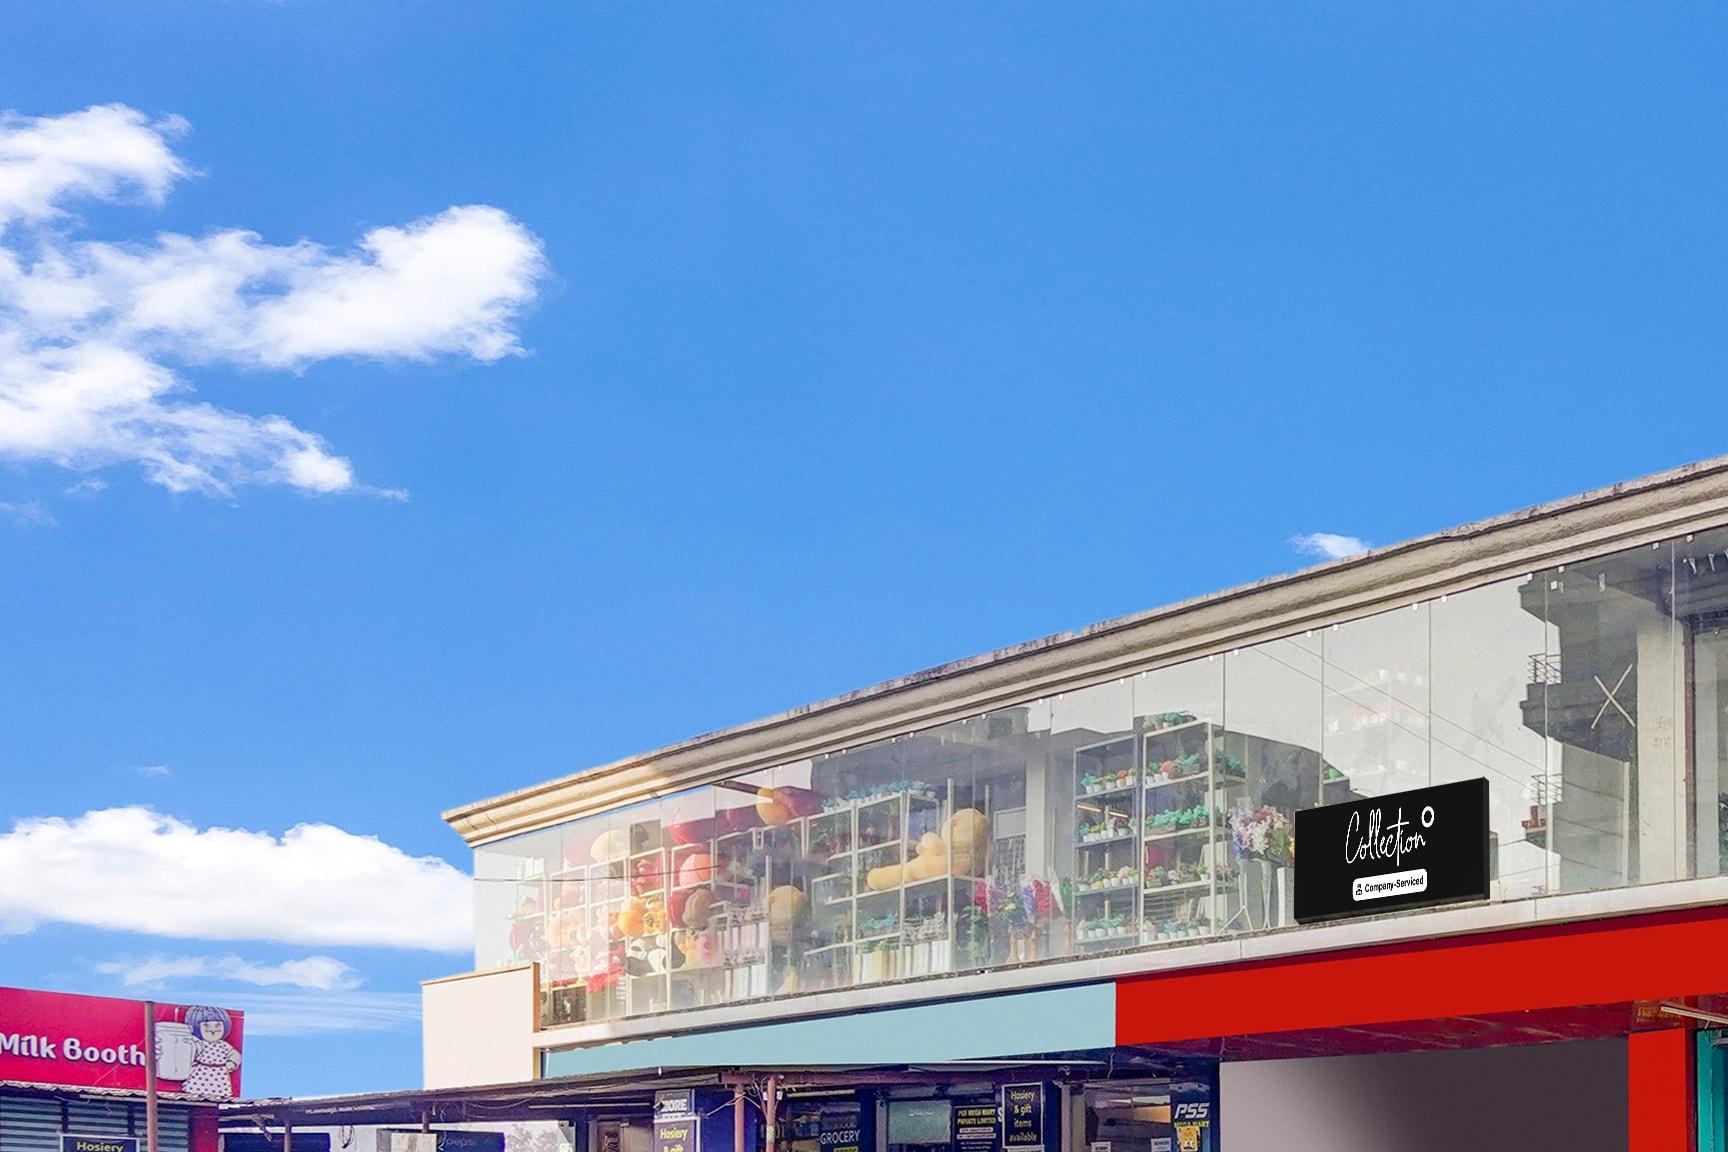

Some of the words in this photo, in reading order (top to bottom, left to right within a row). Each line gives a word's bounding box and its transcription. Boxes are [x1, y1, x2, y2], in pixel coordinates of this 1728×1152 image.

[1345, 807, 1427, 867] Collection
[1364, 874, 1424, 893] Company-Serviced
[0, 1032, 56, 1059] Milk
[62, 1037, 146, 1067] Booth
[1010, 1090, 1035, 1101] Hosiery
[1020, 1103, 1032, 1116] gift
[1174, 1102, 1211, 1119] PSS
[660, 1127, 688, 1141] Hosiery
[820, 1130, 861, 1145] GROCERY
